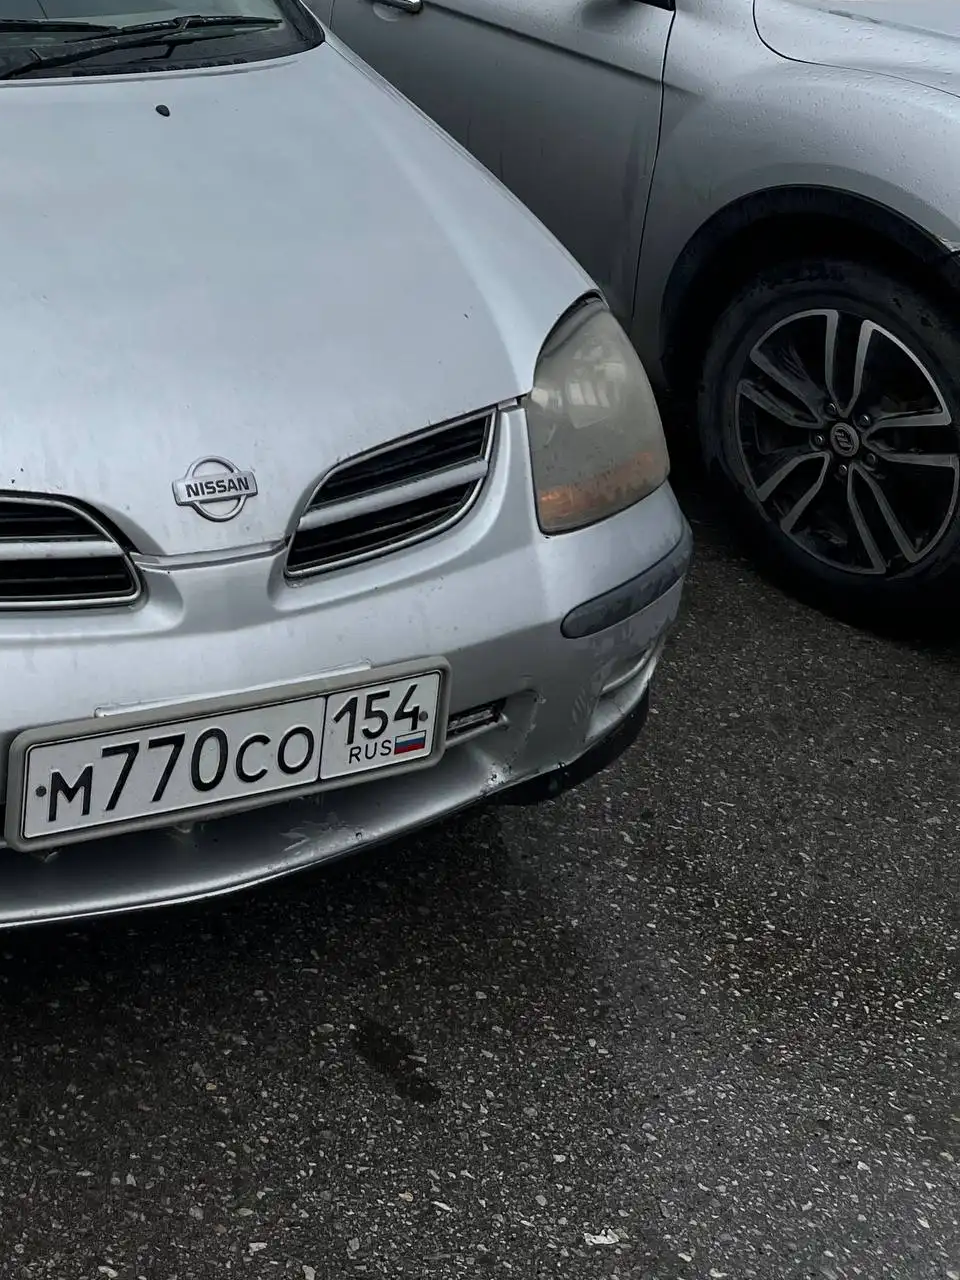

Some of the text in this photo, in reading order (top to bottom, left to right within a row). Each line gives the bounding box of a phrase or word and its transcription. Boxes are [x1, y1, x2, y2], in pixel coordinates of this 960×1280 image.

[184, 477, 250, 498] NISSAN
[333, 683, 420, 746] 154
[348, 739, 392, 764] RUS
